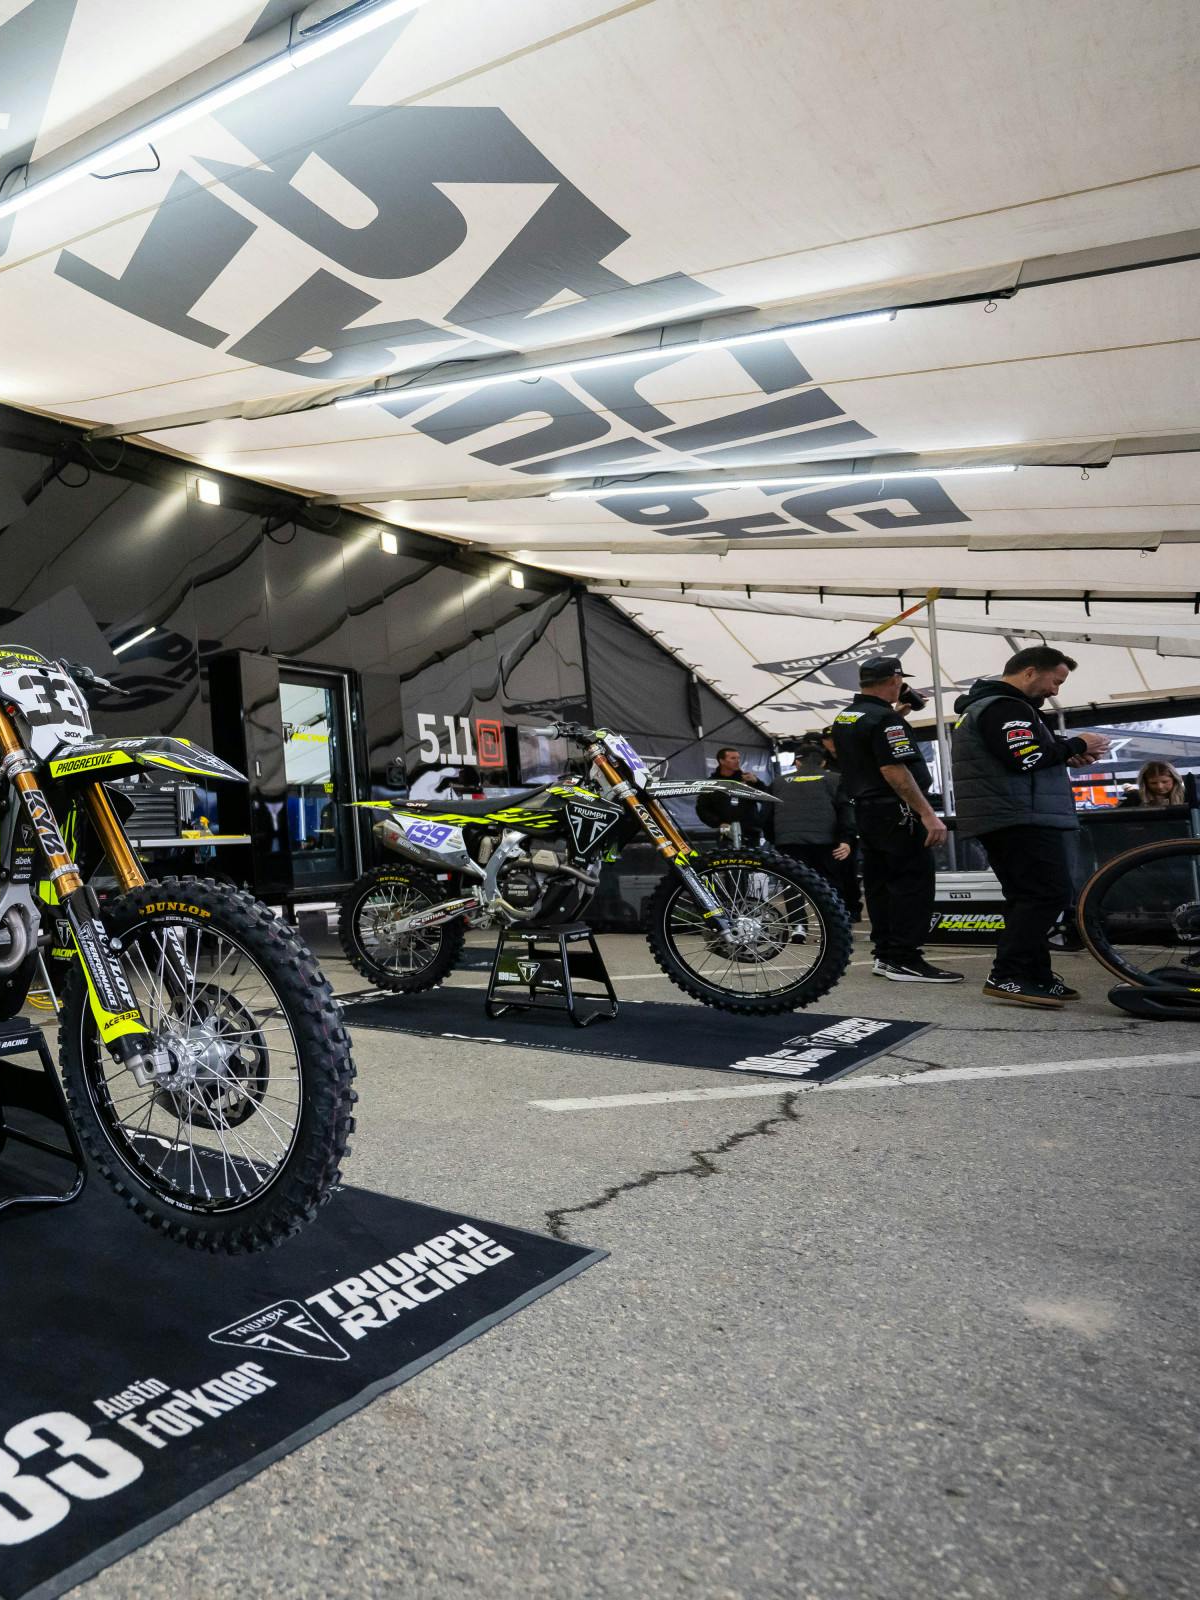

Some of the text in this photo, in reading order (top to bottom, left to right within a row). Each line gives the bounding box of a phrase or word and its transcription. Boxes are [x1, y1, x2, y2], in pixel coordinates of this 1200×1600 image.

[17, 674, 87, 728] 33
[418, 713, 478, 765] 5.11
[55, 753, 114, 774] PROGRESSIVE
[654, 786, 702, 797] PROGRESSIVE
[573, 806, 607, 820] TRIUMPH
[405, 822, 453, 848] 199
[142, 902, 211, 918] DUNLOP
[942, 914, 1005, 923] TRIUMP
[938, 921, 1006, 930] RACING
[86, 941, 118, 1006] PERFORMANCE
[103, 1009, 140, 1031] ACERBIS
[1, 1037, 29, 1049] RACING
[305, 1223, 490, 1317] TRIUMPH
[338, 1240, 515, 1341] RACING
[227, 1308, 288, 1338] TRIUMPH
[92, 1376, 171, 1420] Austin
[116, 1361, 277, 1449] Forkner
